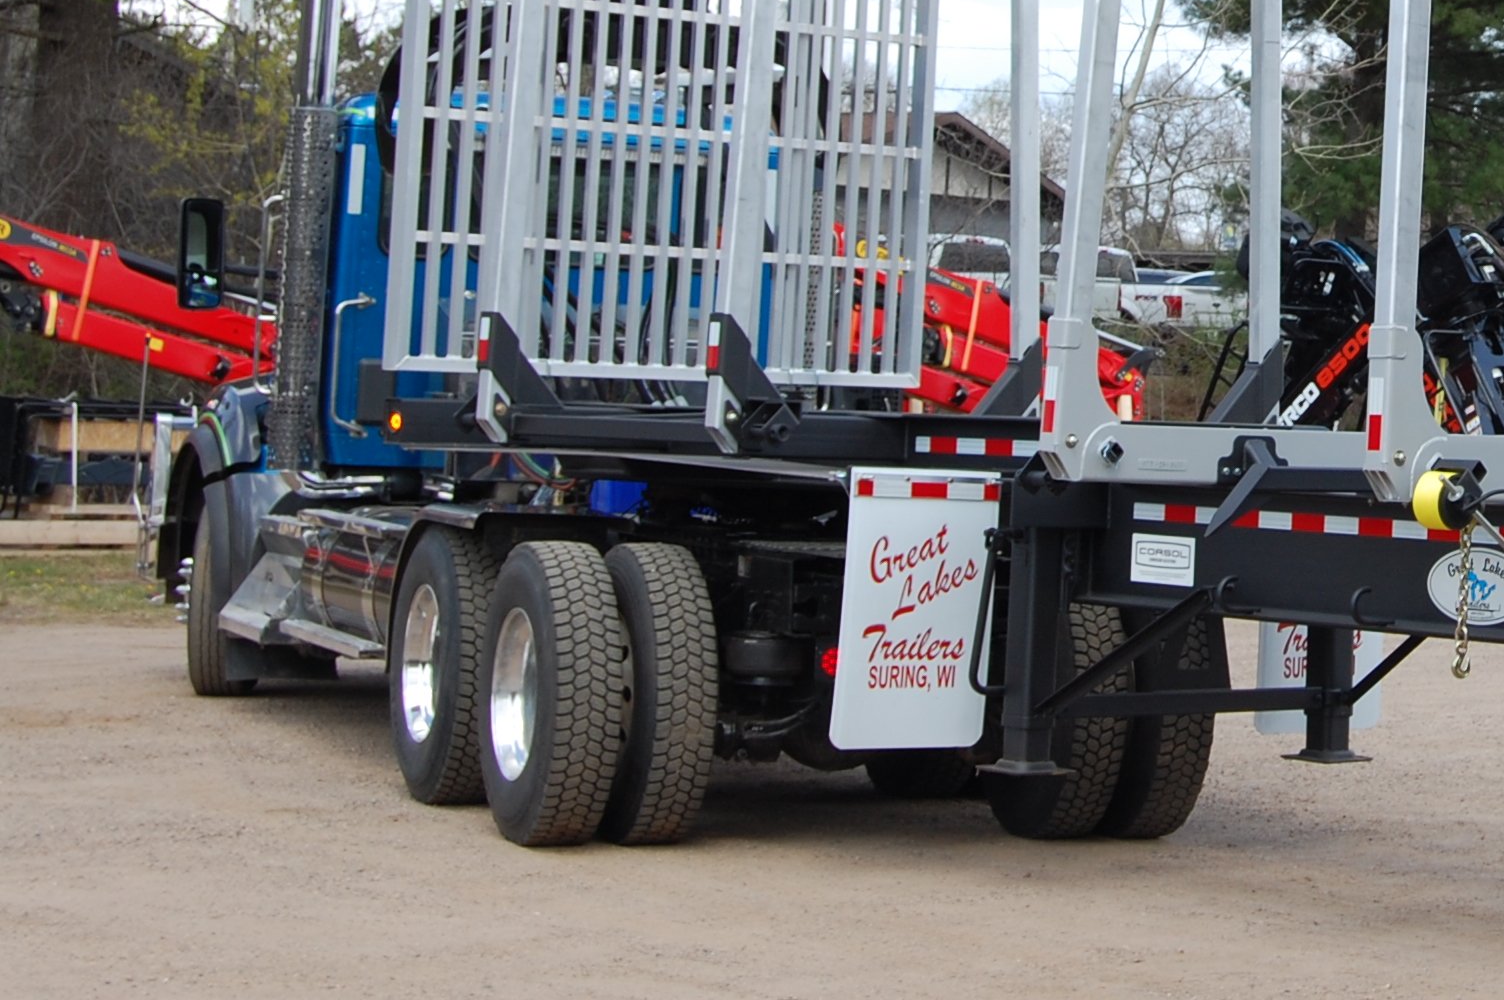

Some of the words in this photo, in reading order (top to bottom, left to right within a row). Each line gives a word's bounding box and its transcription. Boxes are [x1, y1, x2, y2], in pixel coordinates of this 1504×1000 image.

[1277, 381, 1321, 427] RCO
[1316, 323, 1371, 389] 8500
[869, 523, 950, 584] Great
[891, 557, 979, 622] Lakes
[862, 623, 966, 664] Trailers
[867, 665, 931, 692] SURING,
[936, 665, 957, 689] WI
